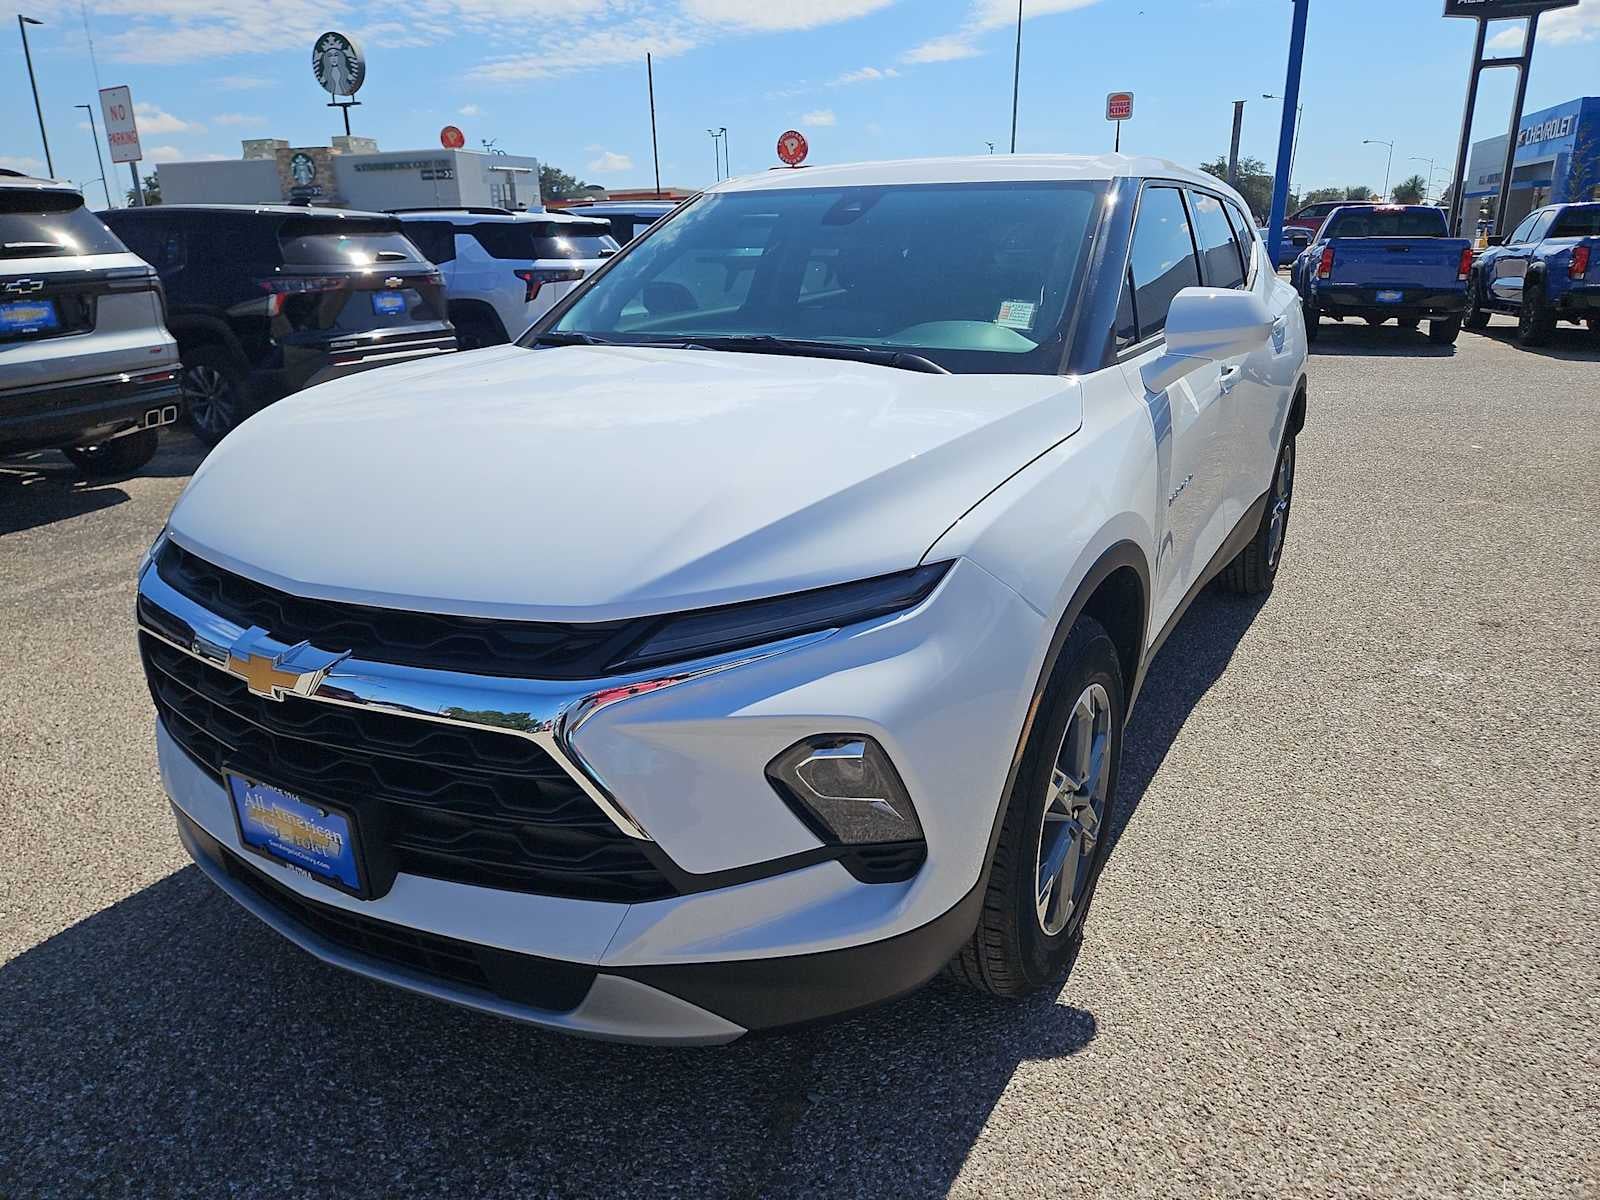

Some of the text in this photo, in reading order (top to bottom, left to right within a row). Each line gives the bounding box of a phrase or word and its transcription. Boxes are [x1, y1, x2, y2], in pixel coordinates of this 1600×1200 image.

[110, 104, 126, 121] NO
[108, 130, 137, 145] PARKING
[1525, 115, 1574, 145] CHEVROLET
[244, 791, 344, 845] All American
